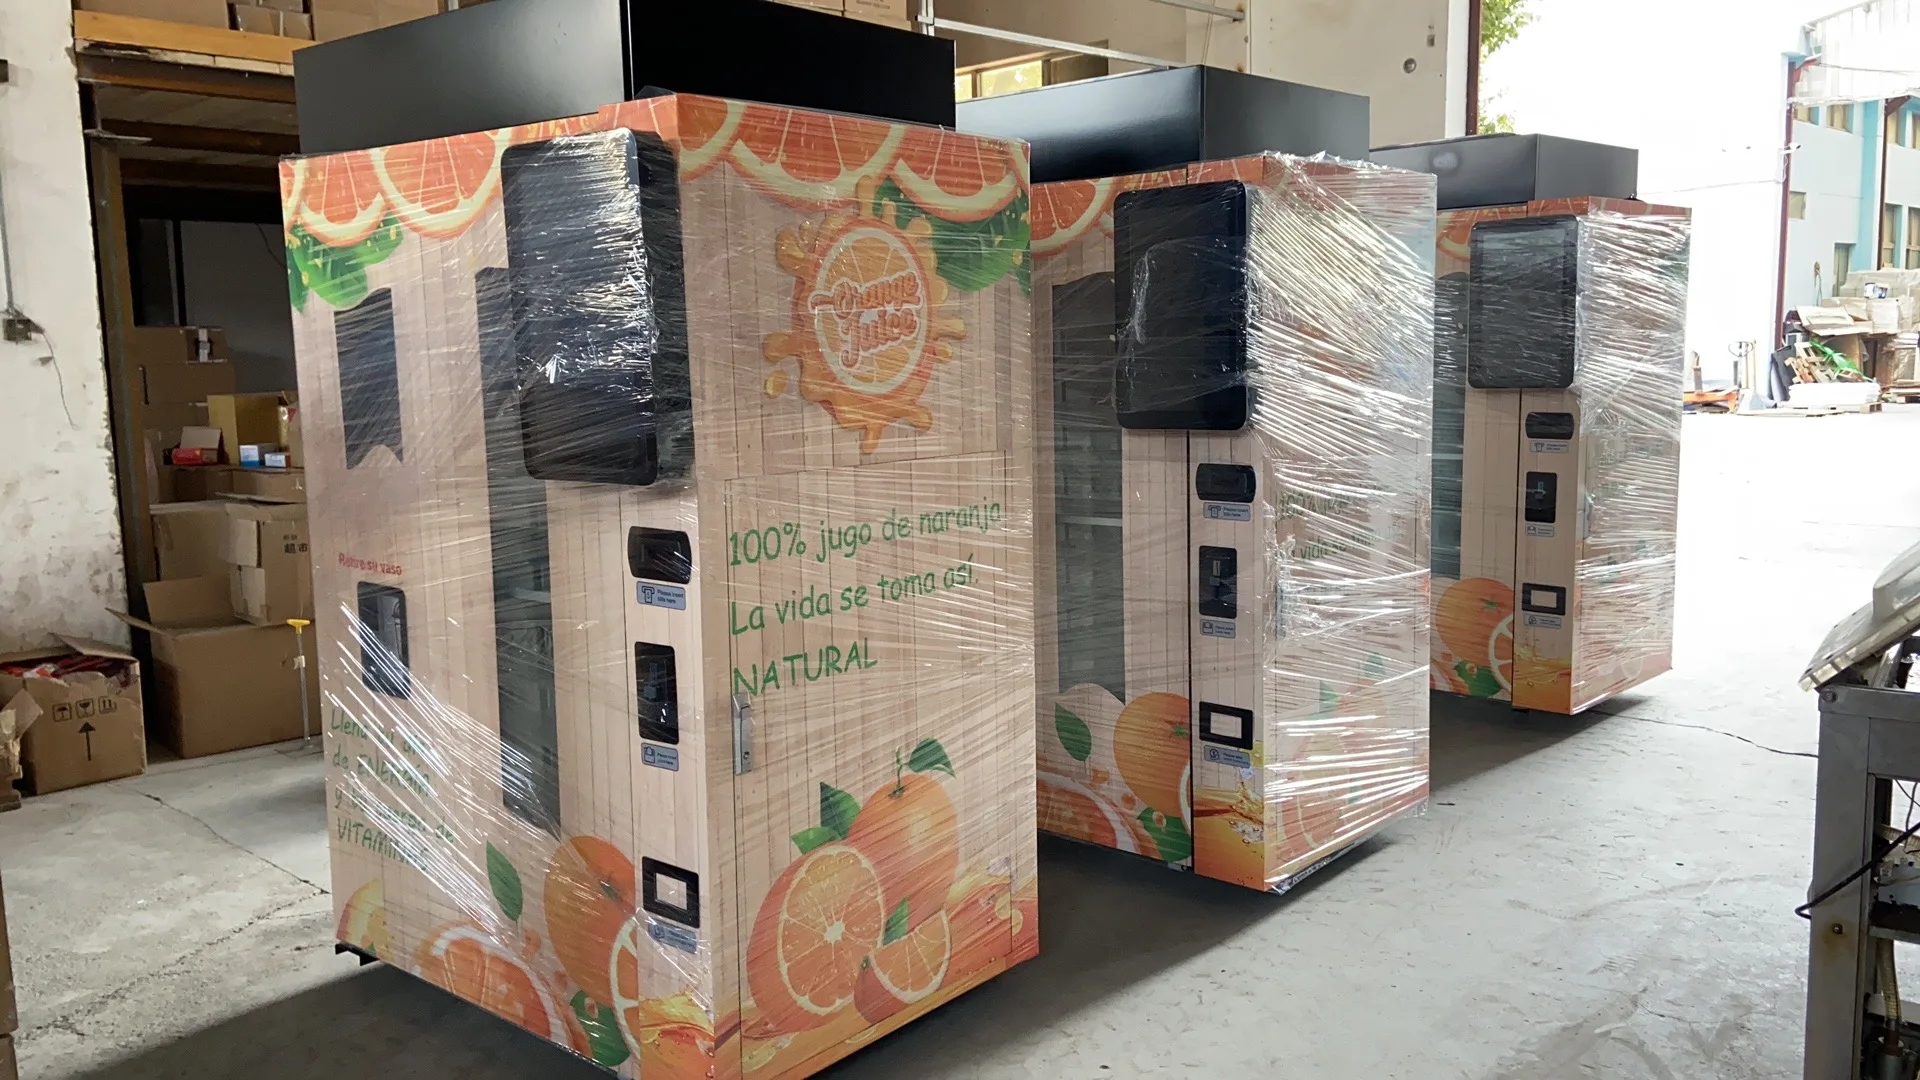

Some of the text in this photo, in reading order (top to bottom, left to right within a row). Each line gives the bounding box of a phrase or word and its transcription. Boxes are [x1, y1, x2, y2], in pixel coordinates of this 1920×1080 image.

[810, 271, 920, 320] Orange
[840, 307, 917, 368] Juice
[729, 496, 1001, 566] 100% jugo de naranja
[380, 562, 402, 576] vaso
[731, 601, 765, 636] La
[775, 584, 832, 625] vida
[840, 585, 868, 612] se
[877, 574, 936, 604] toma
[733, 636, 878, 697] NATURAL
[332, 744, 349, 771] de
[435, 816, 455, 844] de
